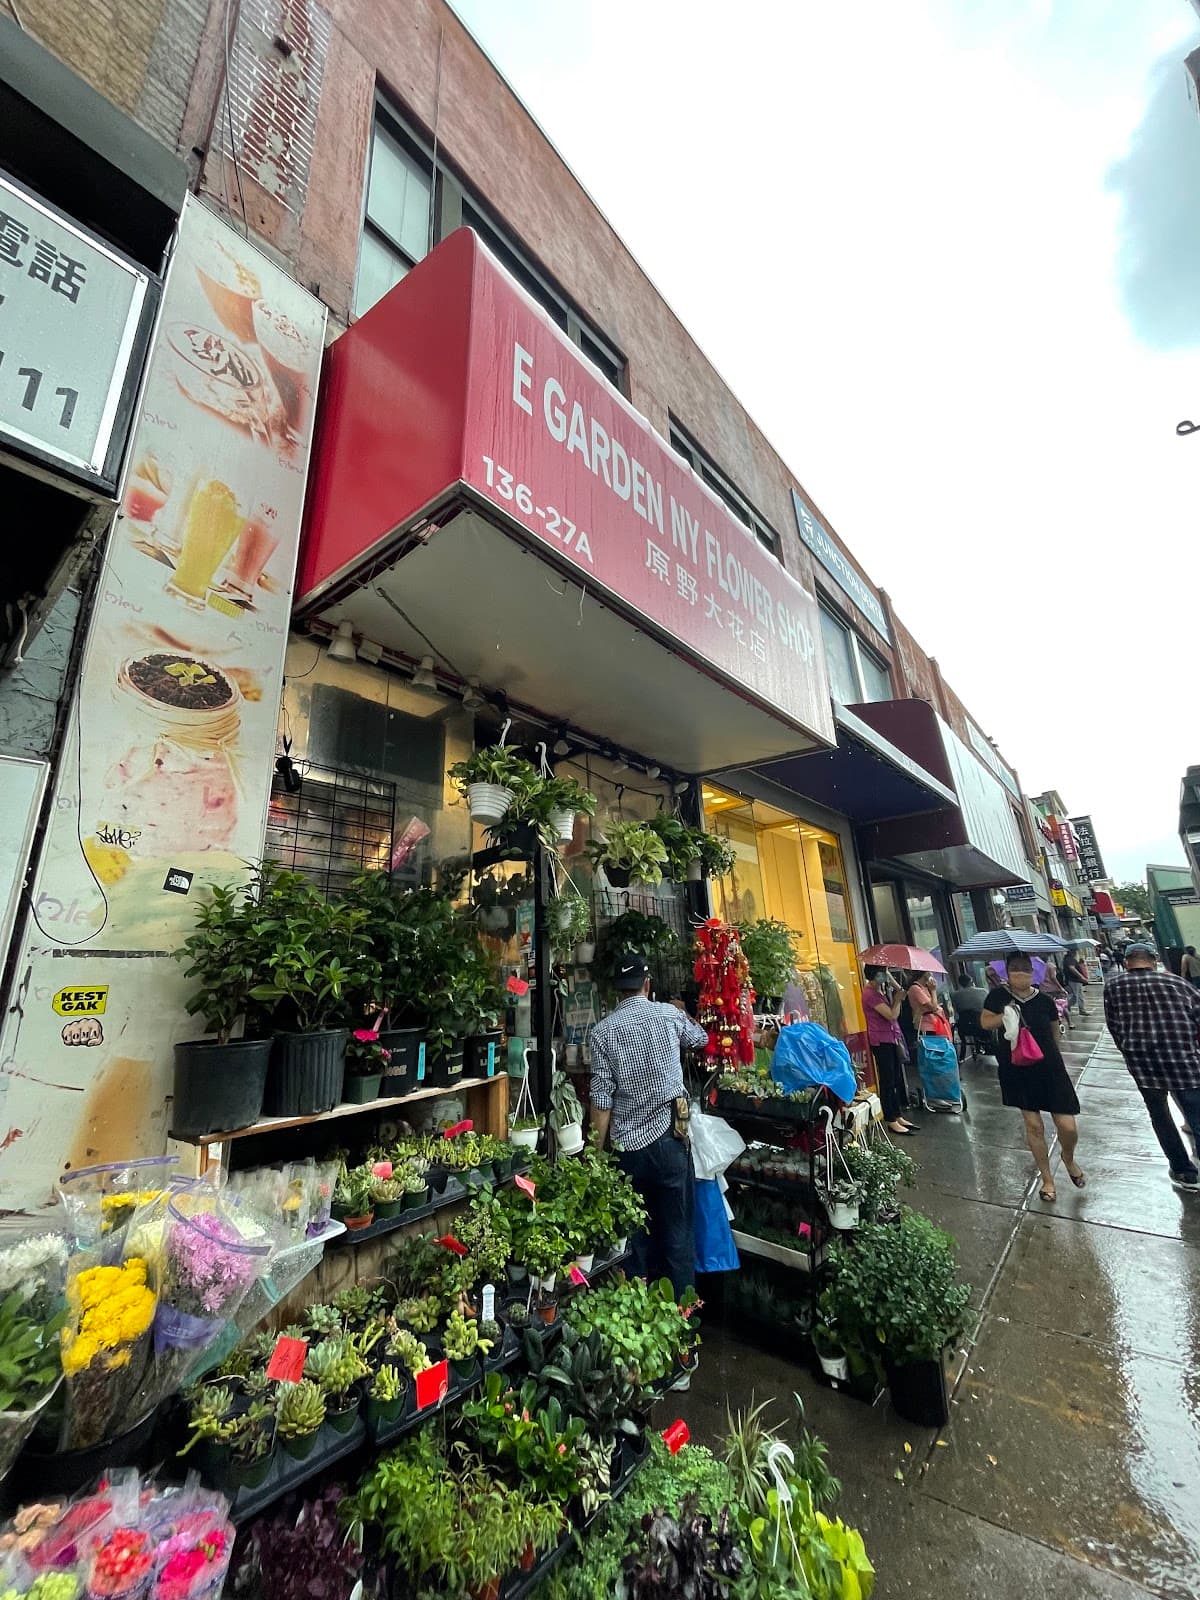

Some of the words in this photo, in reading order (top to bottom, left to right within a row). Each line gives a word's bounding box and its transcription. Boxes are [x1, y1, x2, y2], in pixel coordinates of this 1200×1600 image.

[0, 352, 79, 430] 11
[482, 456, 594, 564] 136-27A
[513, 342, 534, 417] E
[543, 377, 665, 535] GARDEN
[670, 495, 700, 565] NY
[705, 529, 776, 636] FLOWER
[777, 600, 815, 668] SHOP
[645, 538, 767, 663] 原野大花店
[60, 991, 107, 1002] KEST
[61, 1001, 98, 1012] GAK
